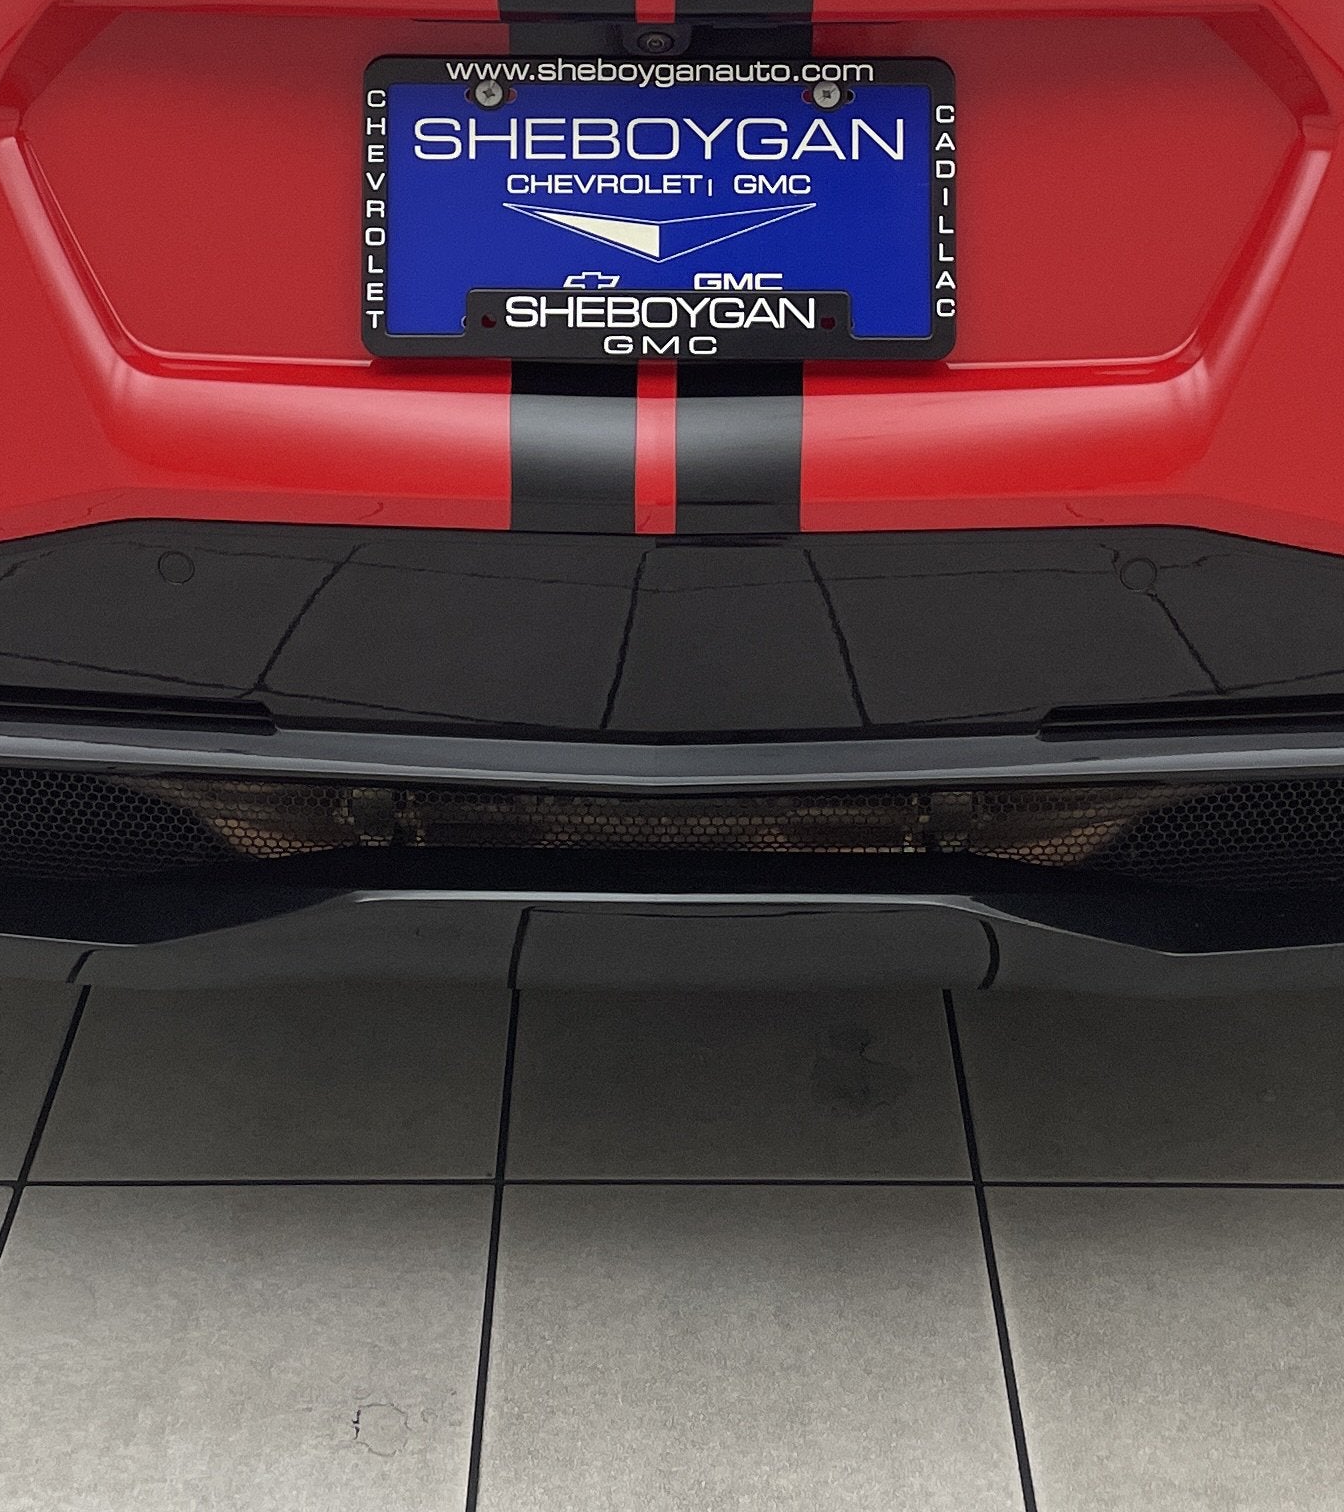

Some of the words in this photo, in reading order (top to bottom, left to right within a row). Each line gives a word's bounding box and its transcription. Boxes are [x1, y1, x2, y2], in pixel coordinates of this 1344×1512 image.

[446, 58, 874, 88] www.sheboyganauto.com
[414, 117, 904, 161] SHEBOYGAN
[506, 174, 703, 195] CHEVROLET
[733, 174, 811, 195] GMC
[365, 89, 386, 329] CHEVROLET
[935, 105, 956, 318] CADILLAC
[693, 273, 783, 290] GMC
[505, 296, 815, 329] SHEBOYGAN
[603, 335, 718, 355] GMC
